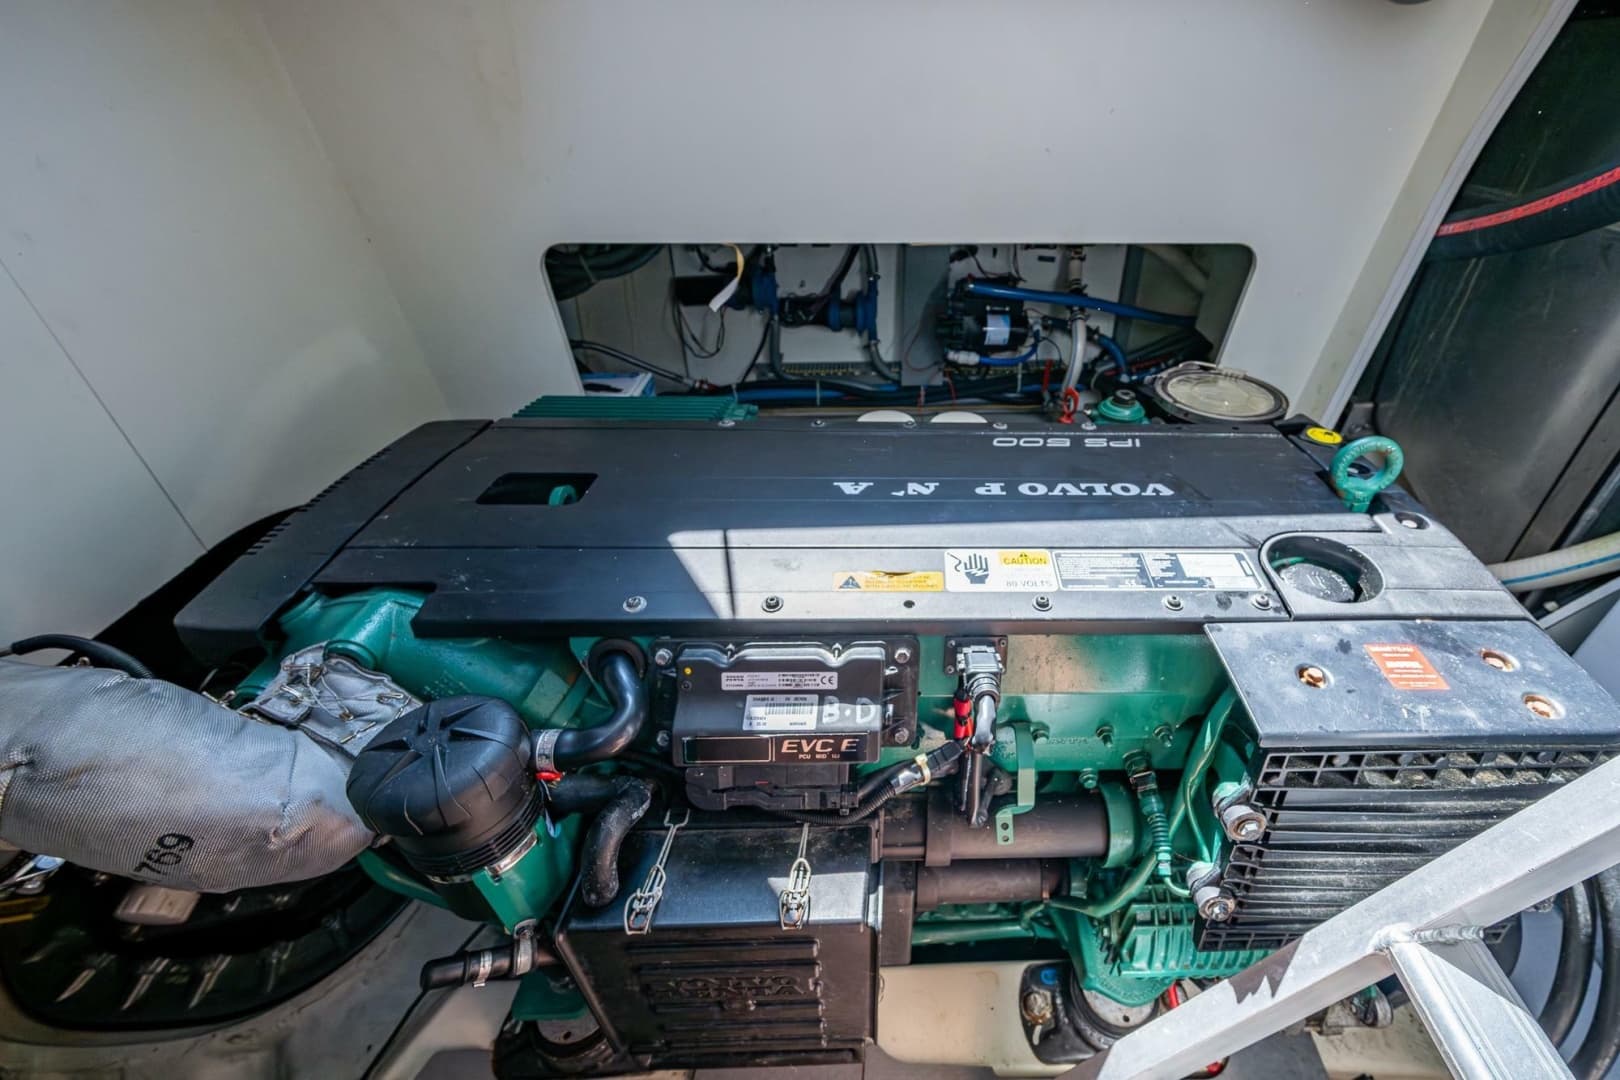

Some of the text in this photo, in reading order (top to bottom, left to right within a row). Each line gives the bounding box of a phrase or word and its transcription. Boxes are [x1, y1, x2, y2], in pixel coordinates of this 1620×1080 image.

[1084, 437, 1141, 448] IPS
[1017, 482, 1175, 497] VOLVO
[1003, 557, 1047, 565] CAUTION
[1020, 580, 1053, 588] VOLTS
[781, 738, 860, 753] EVC E
